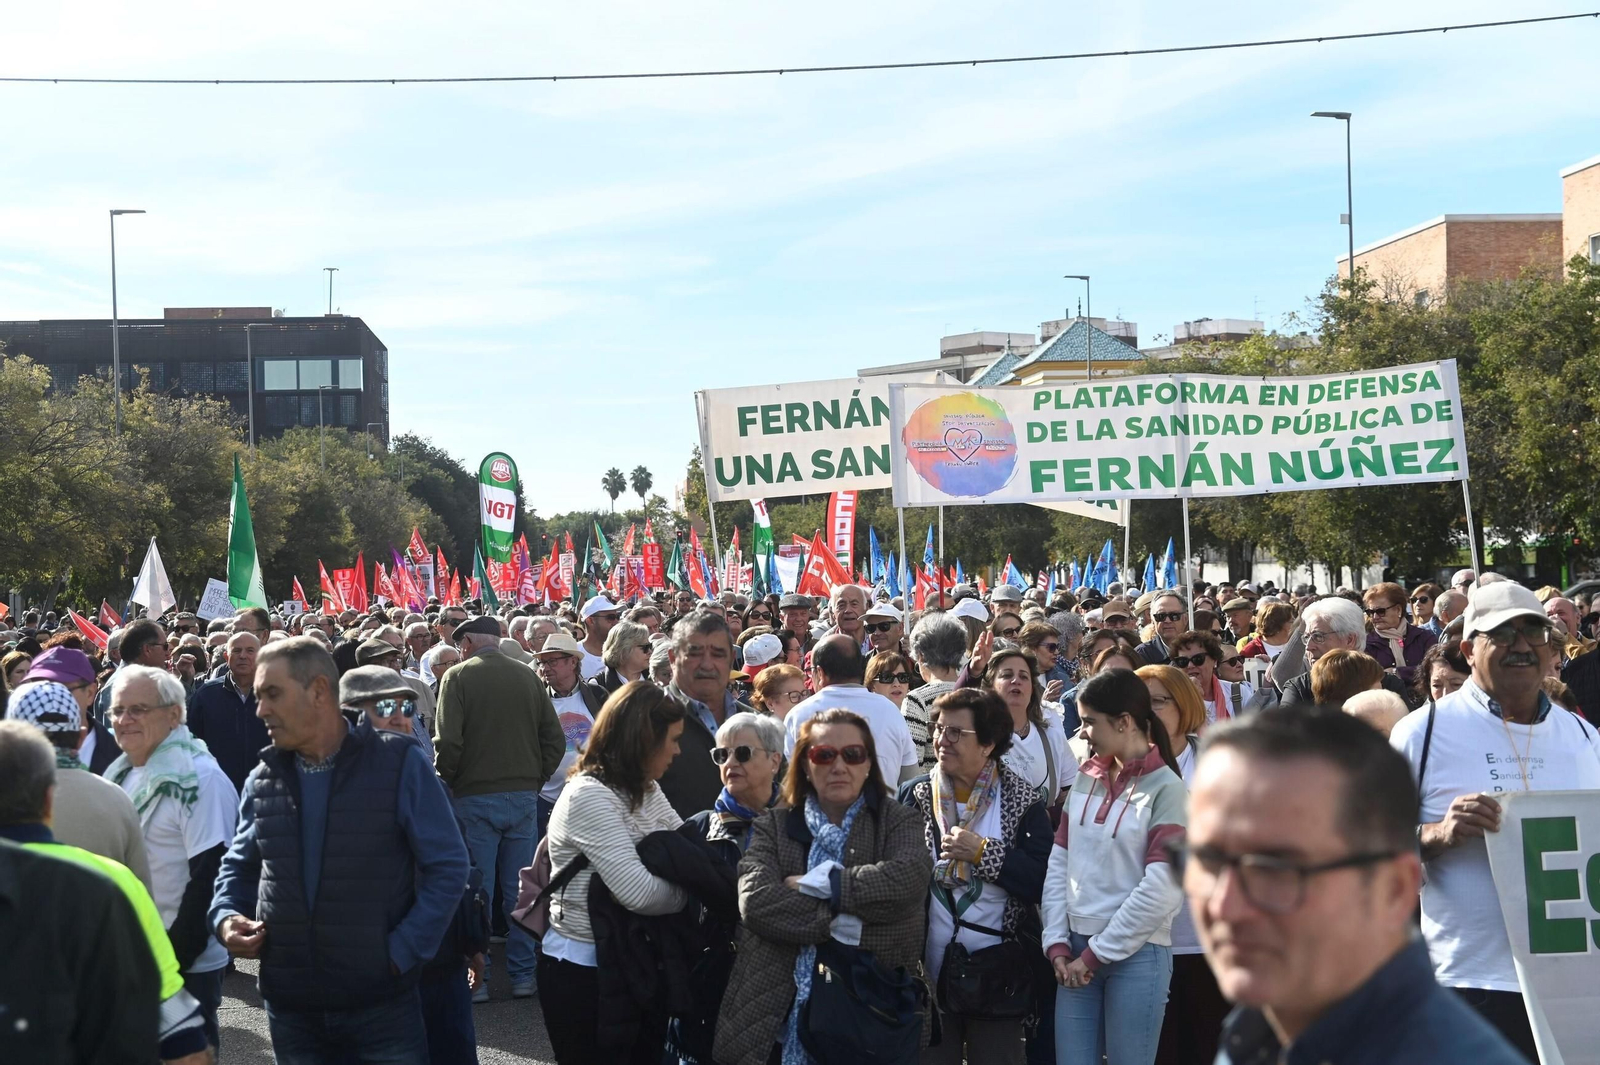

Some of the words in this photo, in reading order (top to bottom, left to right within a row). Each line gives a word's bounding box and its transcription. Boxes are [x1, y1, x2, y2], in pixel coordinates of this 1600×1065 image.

[1033, 381, 1250, 411] PLATAFORMA
[1259, 383, 1300, 407] EN
[1306, 369, 1443, 406] DEFENSA
[1026, 419, 1070, 444] DE
[1076, 417, 1118, 443] LA
[1124, 412, 1264, 441] SANIDAD
[1270, 405, 1404, 437] PÚBLICA
[1410, 399, 1455, 425] DE
[492, 461, 510, 476] UGT
[714, 451, 802, 487] UNA
[1029, 441, 1257, 494] FERNÁN
[1268, 434, 1461, 487] NÚÑEZ
[647, 545, 660, 575] UGT
[1485, 753, 1502, 764] En
[1490, 769, 1534, 780] Sanidad
